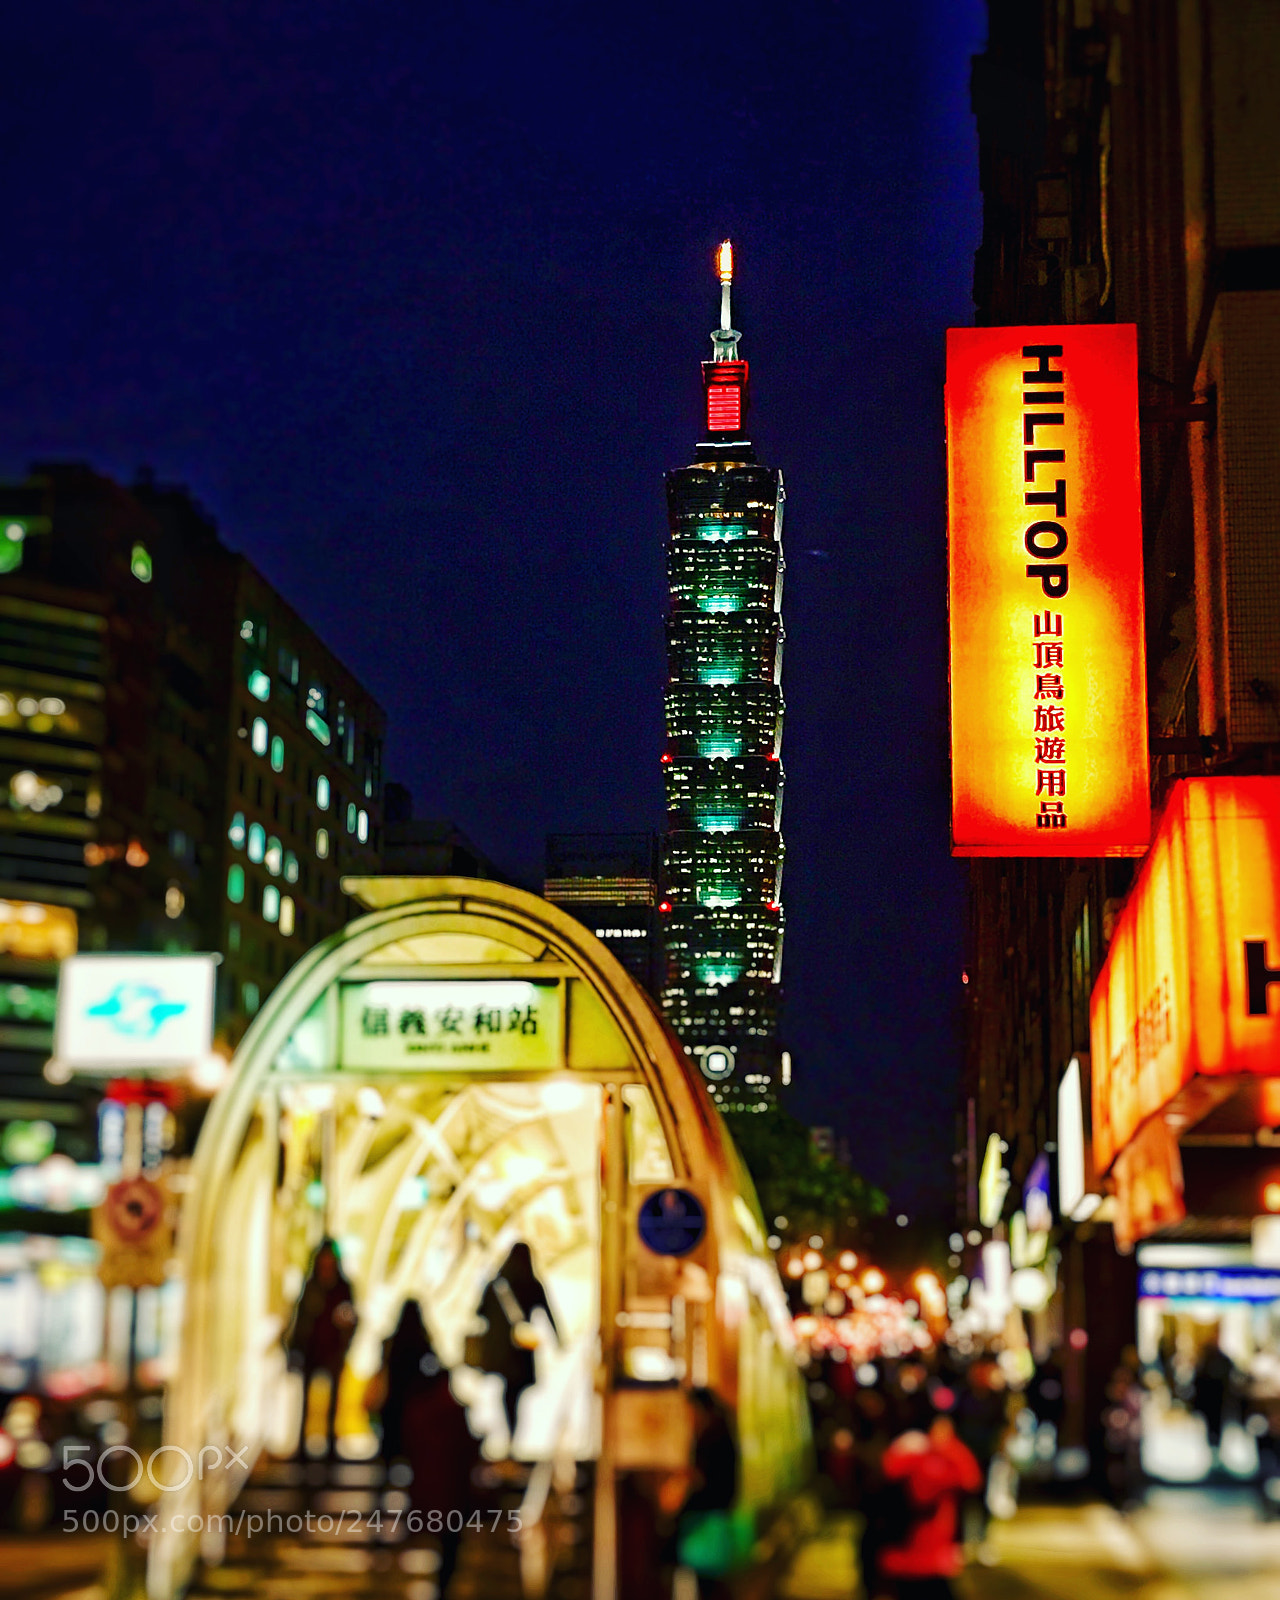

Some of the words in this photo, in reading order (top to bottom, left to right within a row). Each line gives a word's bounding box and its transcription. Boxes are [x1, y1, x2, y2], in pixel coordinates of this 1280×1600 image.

[1022, 345, 1069, 599] HILLTOP
[1032, 610, 1068, 830] 山頂鳥旅遊用品
